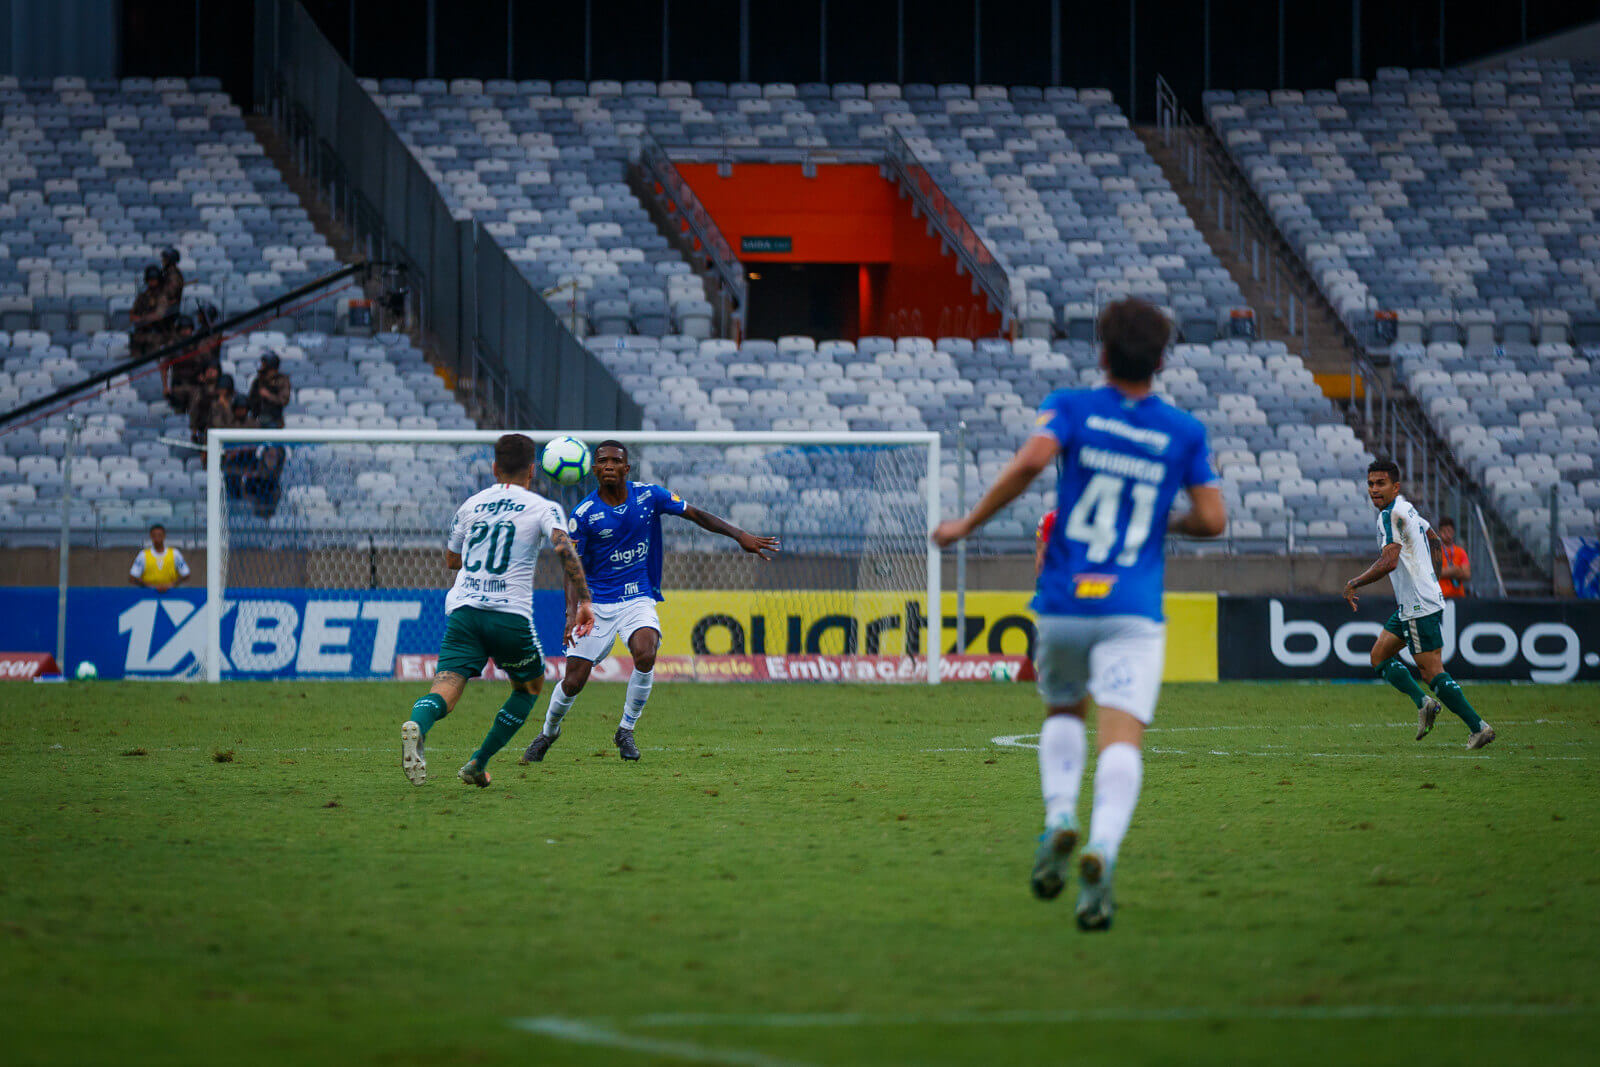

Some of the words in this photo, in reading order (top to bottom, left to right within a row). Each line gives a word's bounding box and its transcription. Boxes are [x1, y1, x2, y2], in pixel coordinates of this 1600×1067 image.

[474, 498, 526, 515] crefisa
[1065, 471, 1159, 567] 41
[464, 520, 516, 575] 20
[482, 579, 506, 592] LIMA
[118, 599, 422, 672] 1XBET
